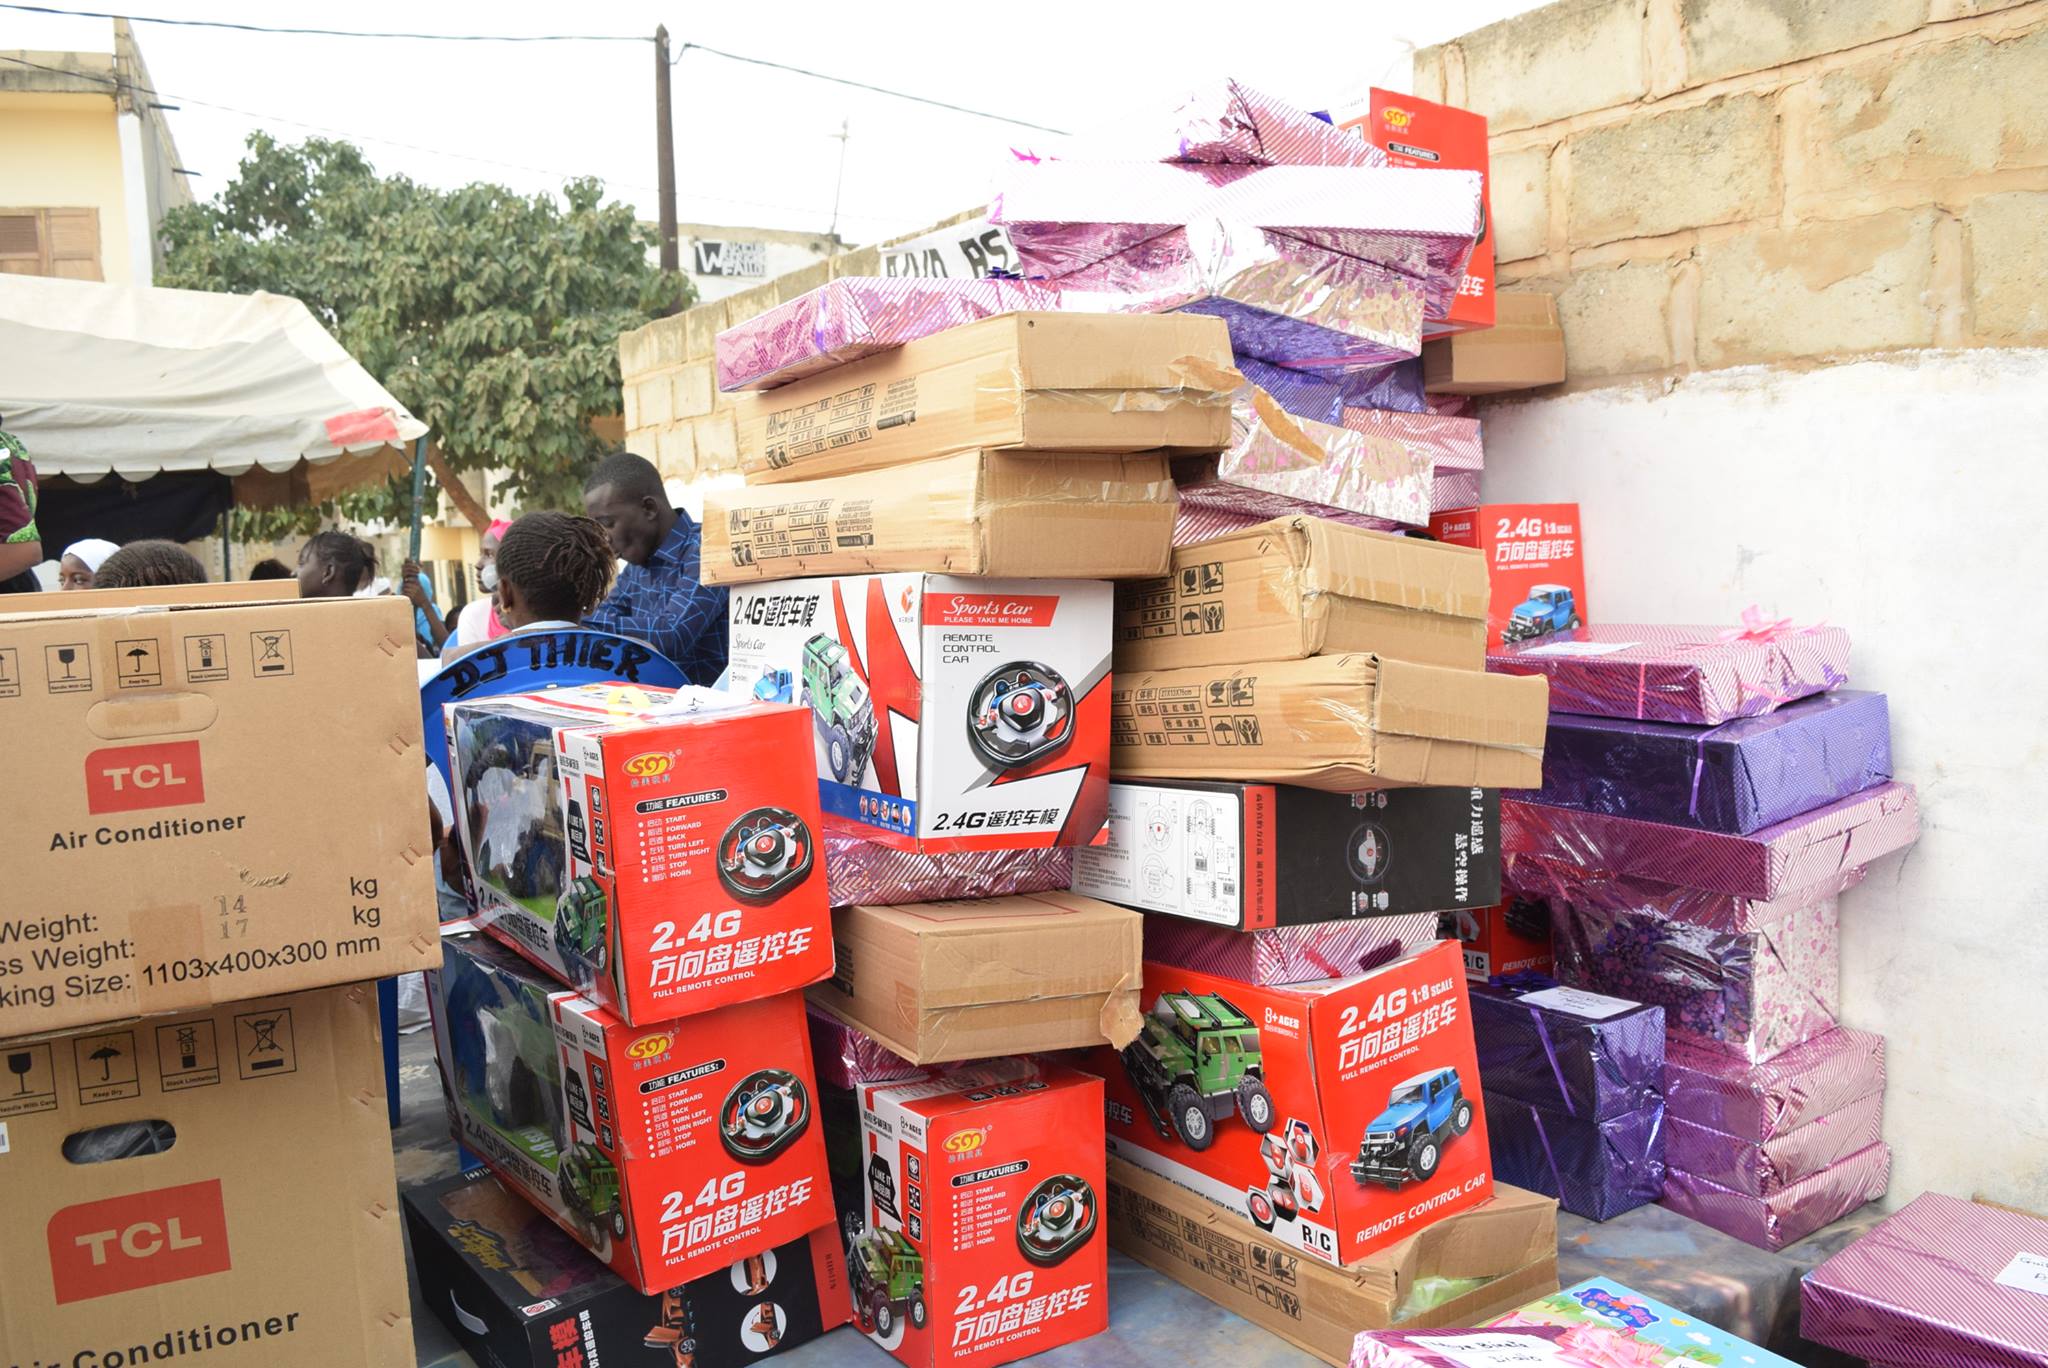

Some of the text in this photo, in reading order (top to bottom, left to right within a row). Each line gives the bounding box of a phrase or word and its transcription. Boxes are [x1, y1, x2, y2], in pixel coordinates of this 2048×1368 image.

[1496, 518, 1542, 538] 2.4G
[943, 595, 1033, 616] Sports Car
[943, 633, 993, 642] REMOTE
[943, 644, 1000, 653] CONTROL
[943, 655, 969, 664] CAR
[102, 763, 187, 791] TCL
[666, 792, 720, 808] FEATURES:
[665, 815, 687, 824] START
[666, 821, 702, 832] FORWARD
[50, 815, 246, 851] Air Conditioner
[667, 834, 686, 842] BACK
[668, 841, 687, 851] TURN
[688, 839, 705, 847] LEFT
[668, 850, 687, 859] TURN
[689, 847, 710, 856] RIGHT
[669, 860, 688, 869] STOP
[670, 869, 691, 878] HORN
[214, 895, 247, 917] 14
[350, 877, 378, 897] kg
[32, 939, 136, 971] Weight:
[353, 906, 381, 927] kg
[649, 909, 742, 952] 2.4G
[649, 927, 813, 988] 方向盘遥控车
[1502, 958, 1536, 972] REMOTE
[65, 974, 131, 998] Size:
[142, 940, 327, 986] 1103x400x300
[336, 936, 380, 957] mm
[653, 970, 756, 998] FULL REMOTE CONTROL
[1338, 978, 1454, 1038] 2.4G 1:8 SCALE
[1338, 997, 1458, 1071] 方向盘遥控车
[1341, 1045, 1419, 1081] FULL REMOTE CONTROL
[667, 1063, 719, 1084] FEATURES:
[668, 1088, 689, 1100] START
[669, 1093, 703, 1108] FORWARD
[670, 1106, 689, 1117] BACK
[672, 1114, 691, 1125] TURN
[691, 1109, 707, 1118] LEFT
[673, 1122, 692, 1133] TURN
[693, 1116, 713, 1128] RIGHT
[674, 1132, 692, 1142] STOP
[676, 1139, 697, 1151] HORN
[977, 1163, 1023, 1180] FEATURES:
[659, 1170, 746, 1224] 2.4G
[975, 1186, 994, 1195] START
[976, 1191, 1006, 1203] FORWARD
[661, 1176, 814, 1256] 方向盘遥控车
[975, 1203, 993, 1212] BACK
[976, 1211, 993, 1221] TURN
[993, 1207, 1008, 1217] LEFT
[1355, 1172, 1487, 1244] REMOTE CONTROL CAR
[976, 1220, 993, 1229] TURN
[994, 1215, 1012, 1225] RIGHT
[74, 1216, 203, 1266] TCL
[976, 1228, 993, 1238] STOP
[976, 1236, 996, 1245] HORN
[1302, 1223, 1331, 1251] R/C
[665, 1226, 761, 1267] FULL REMOTE CONTROL
[953, 1270, 1035, 1316] 2.4G
[951, 1283, 1093, 1348] 方向盘遥控车
[72, 1311, 300, 1368] Conditioner
[954, 1326, 1041, 1358] FULL REMOTE CONTROL
